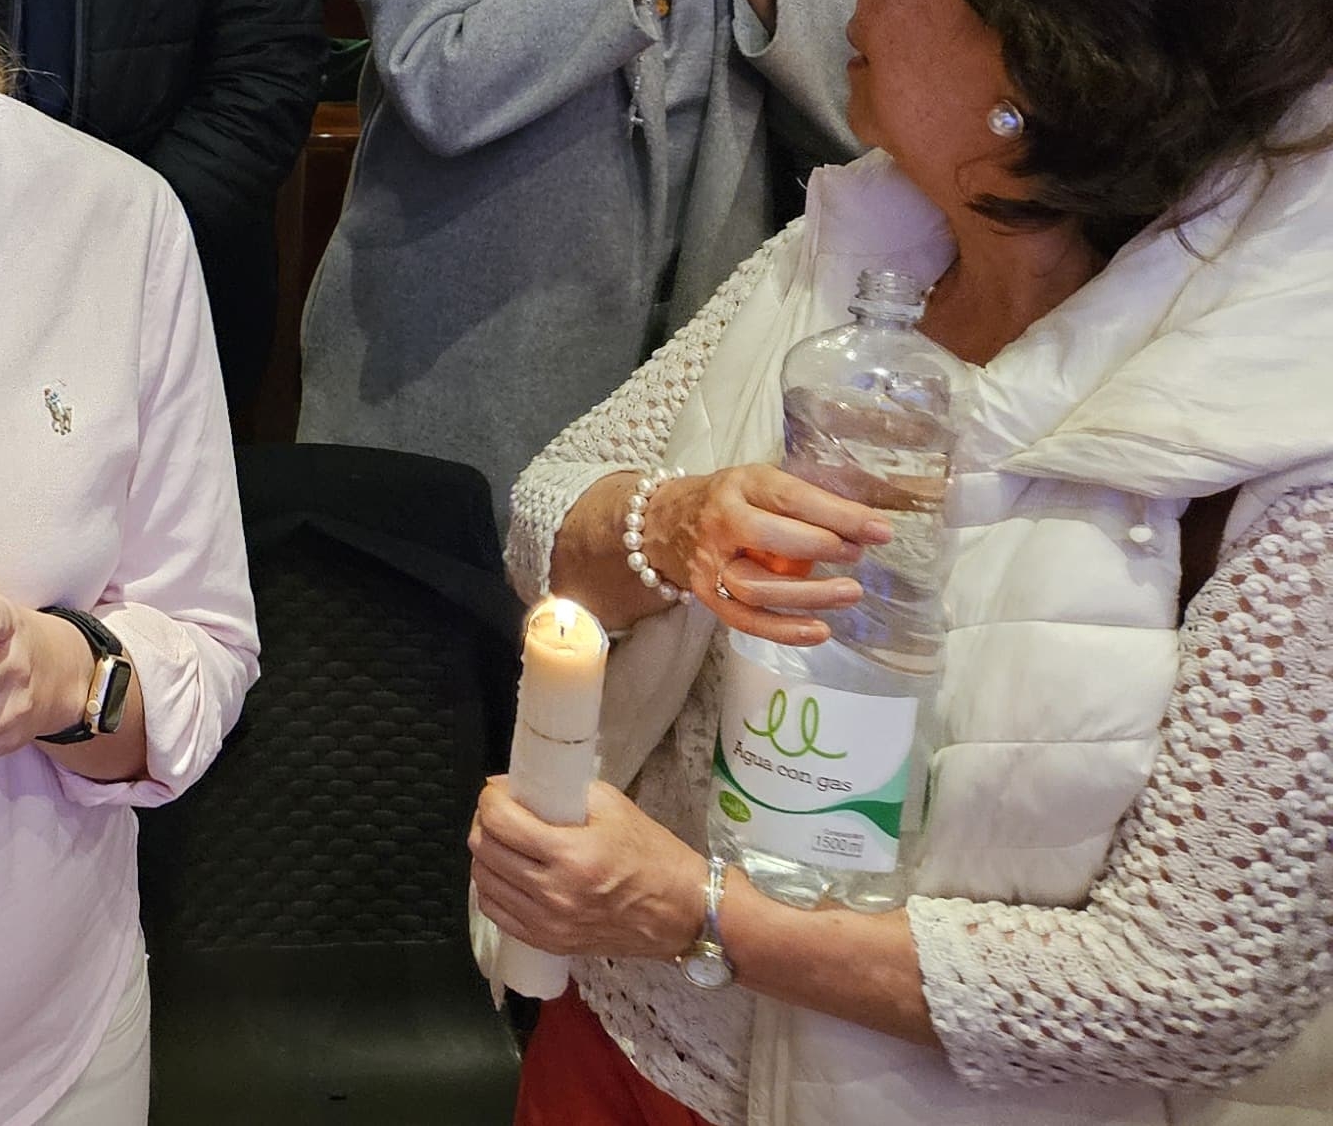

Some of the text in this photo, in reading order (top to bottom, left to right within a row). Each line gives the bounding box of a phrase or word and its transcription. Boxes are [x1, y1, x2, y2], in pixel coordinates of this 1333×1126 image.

[733, 739, 853, 792] Agua con gas
